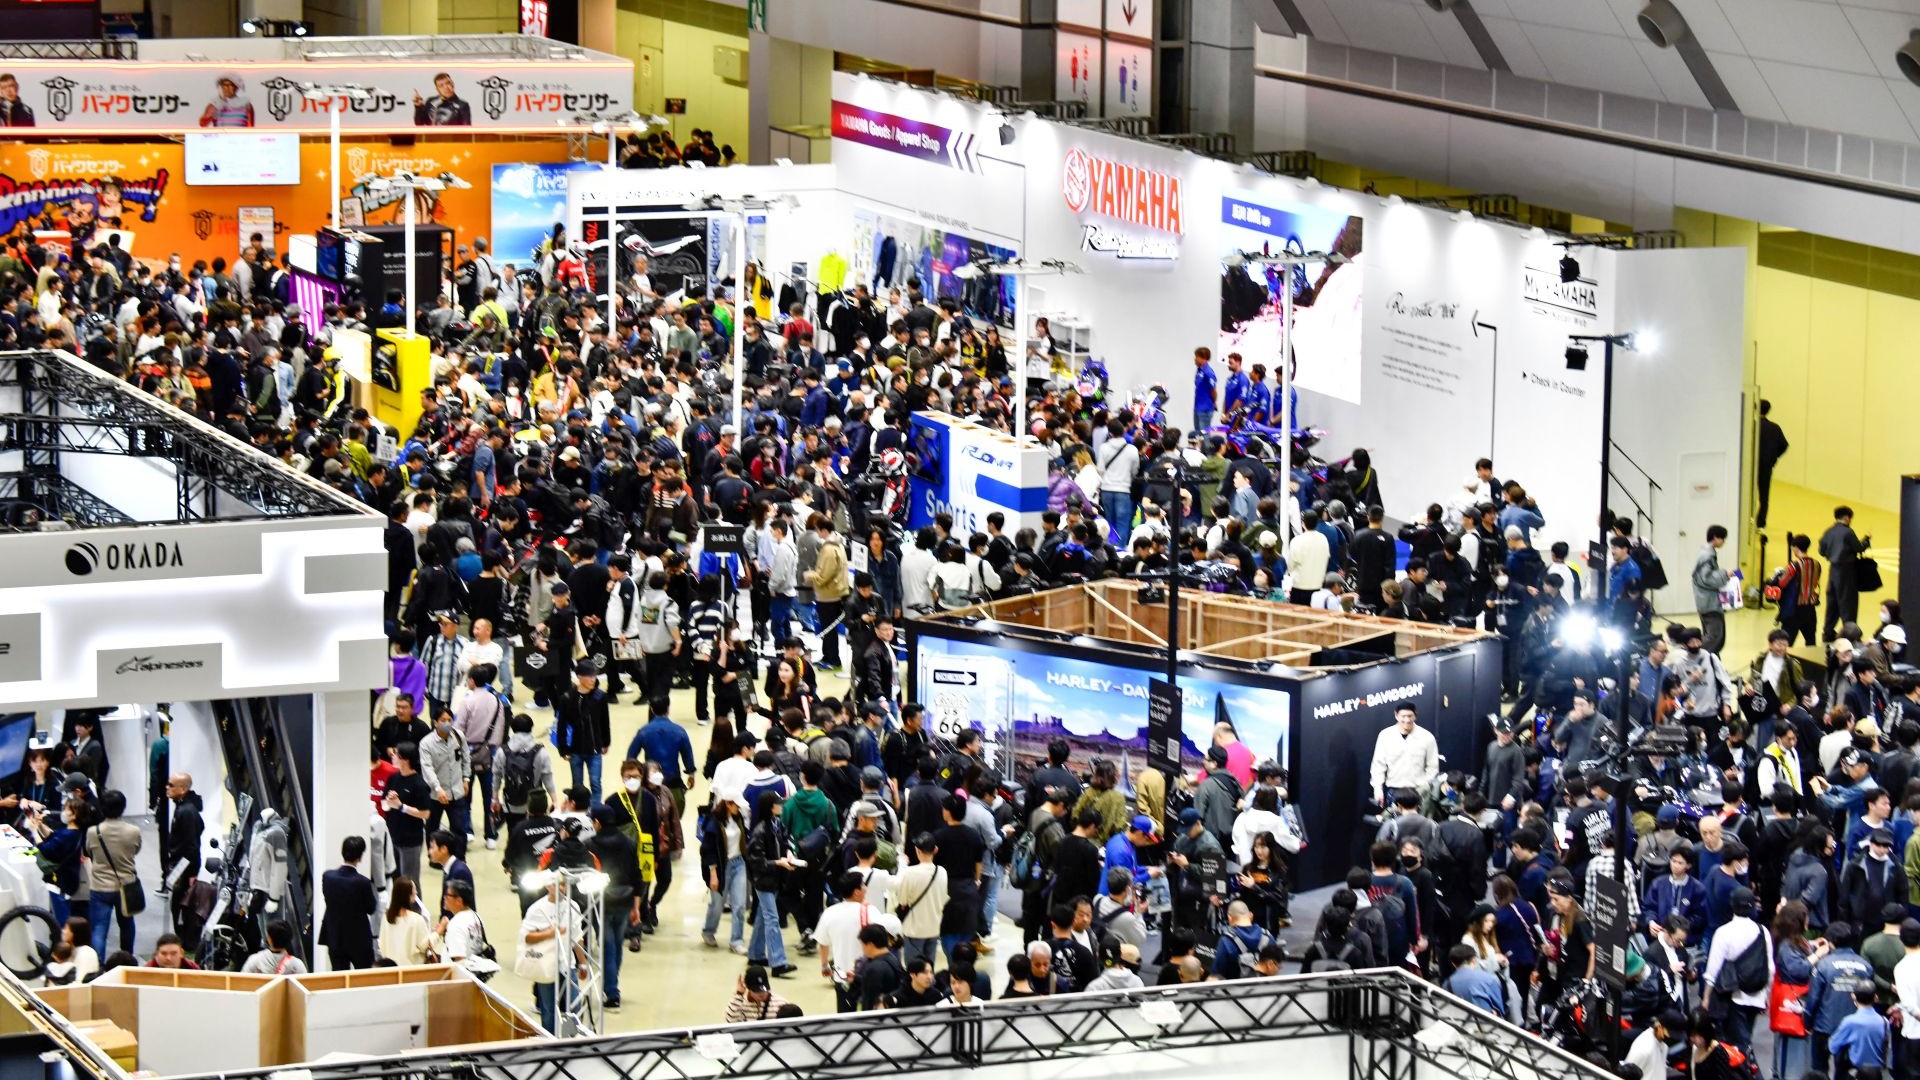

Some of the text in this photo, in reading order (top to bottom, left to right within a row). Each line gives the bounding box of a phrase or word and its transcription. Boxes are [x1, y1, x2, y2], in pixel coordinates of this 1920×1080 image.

[81, 93, 190, 114] バイクセンサー
[514, 93, 619, 112] バイクセンサー
[869, 119, 891, 140] Goods
[921, 132, 940, 155] Shop
[53, 159, 126, 174] バイクセンサー
[1088, 156, 1184, 236] YAMAHA
[710, 218, 720, 285] Collection
[1531, 372, 1550, 388] Check
[1560, 381, 1586, 398] Counter
[925, 488, 977, 535] Sports
[106, 541, 184, 570] OKADA
[140, 657, 204, 672] alpinestars
[1046, 671, 1206, 708] HARLEY-DAVON
[940, 717, 962, 736] 66
